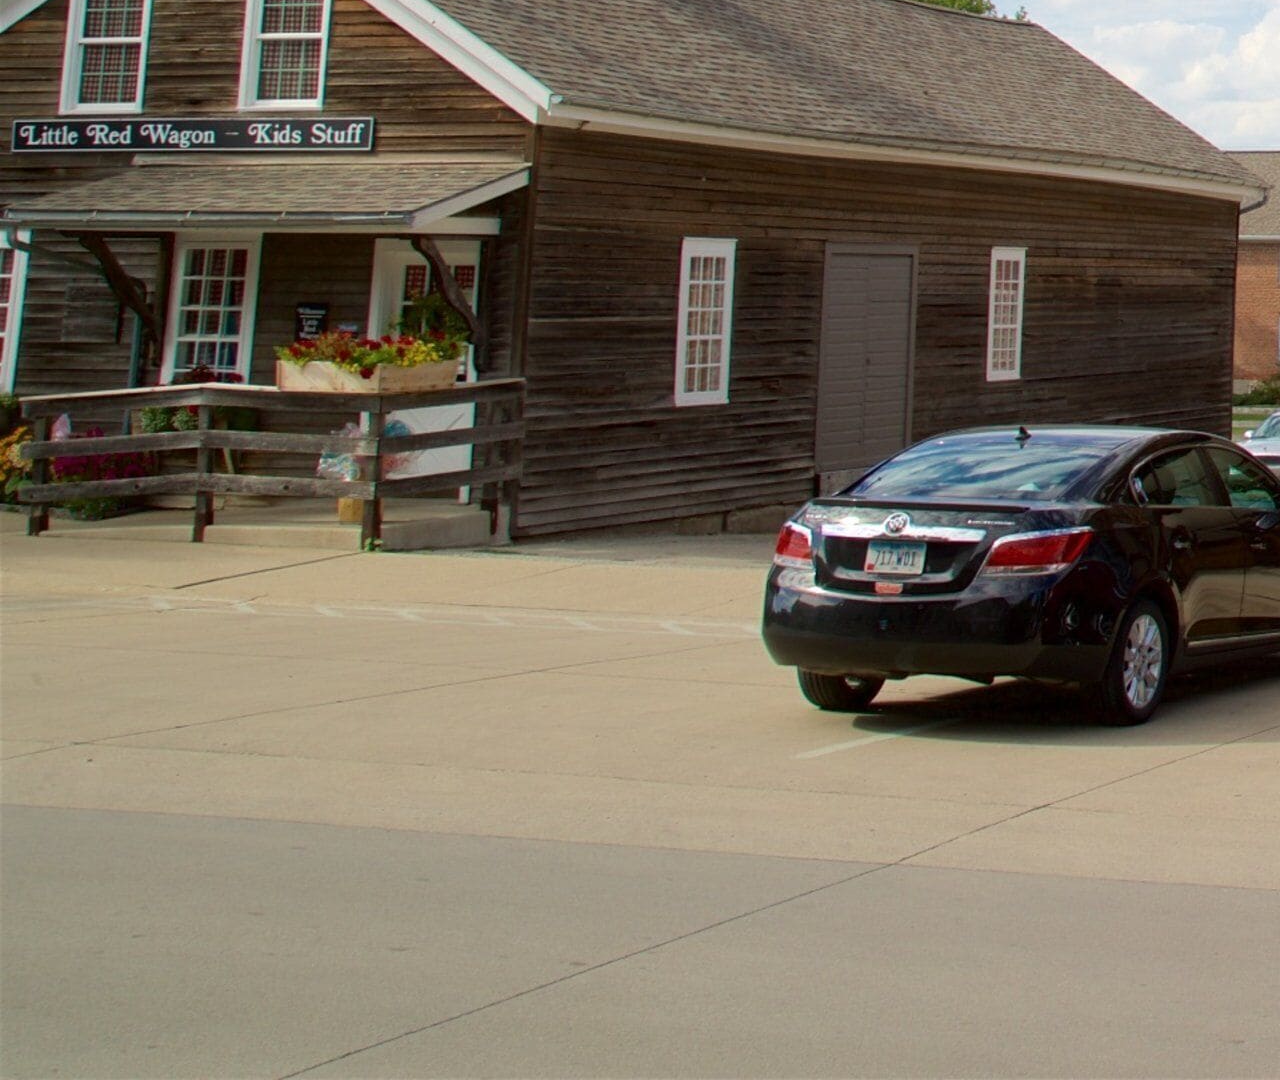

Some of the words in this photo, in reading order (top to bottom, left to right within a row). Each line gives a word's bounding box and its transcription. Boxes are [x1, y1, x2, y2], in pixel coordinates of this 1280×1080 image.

[19, 124, 78, 146] Little
[85, 124, 132, 145] Red
[139, 123, 216, 148] Wagon
[247, 122, 302, 144] Kids
[310, 122, 365, 144] Stuff
